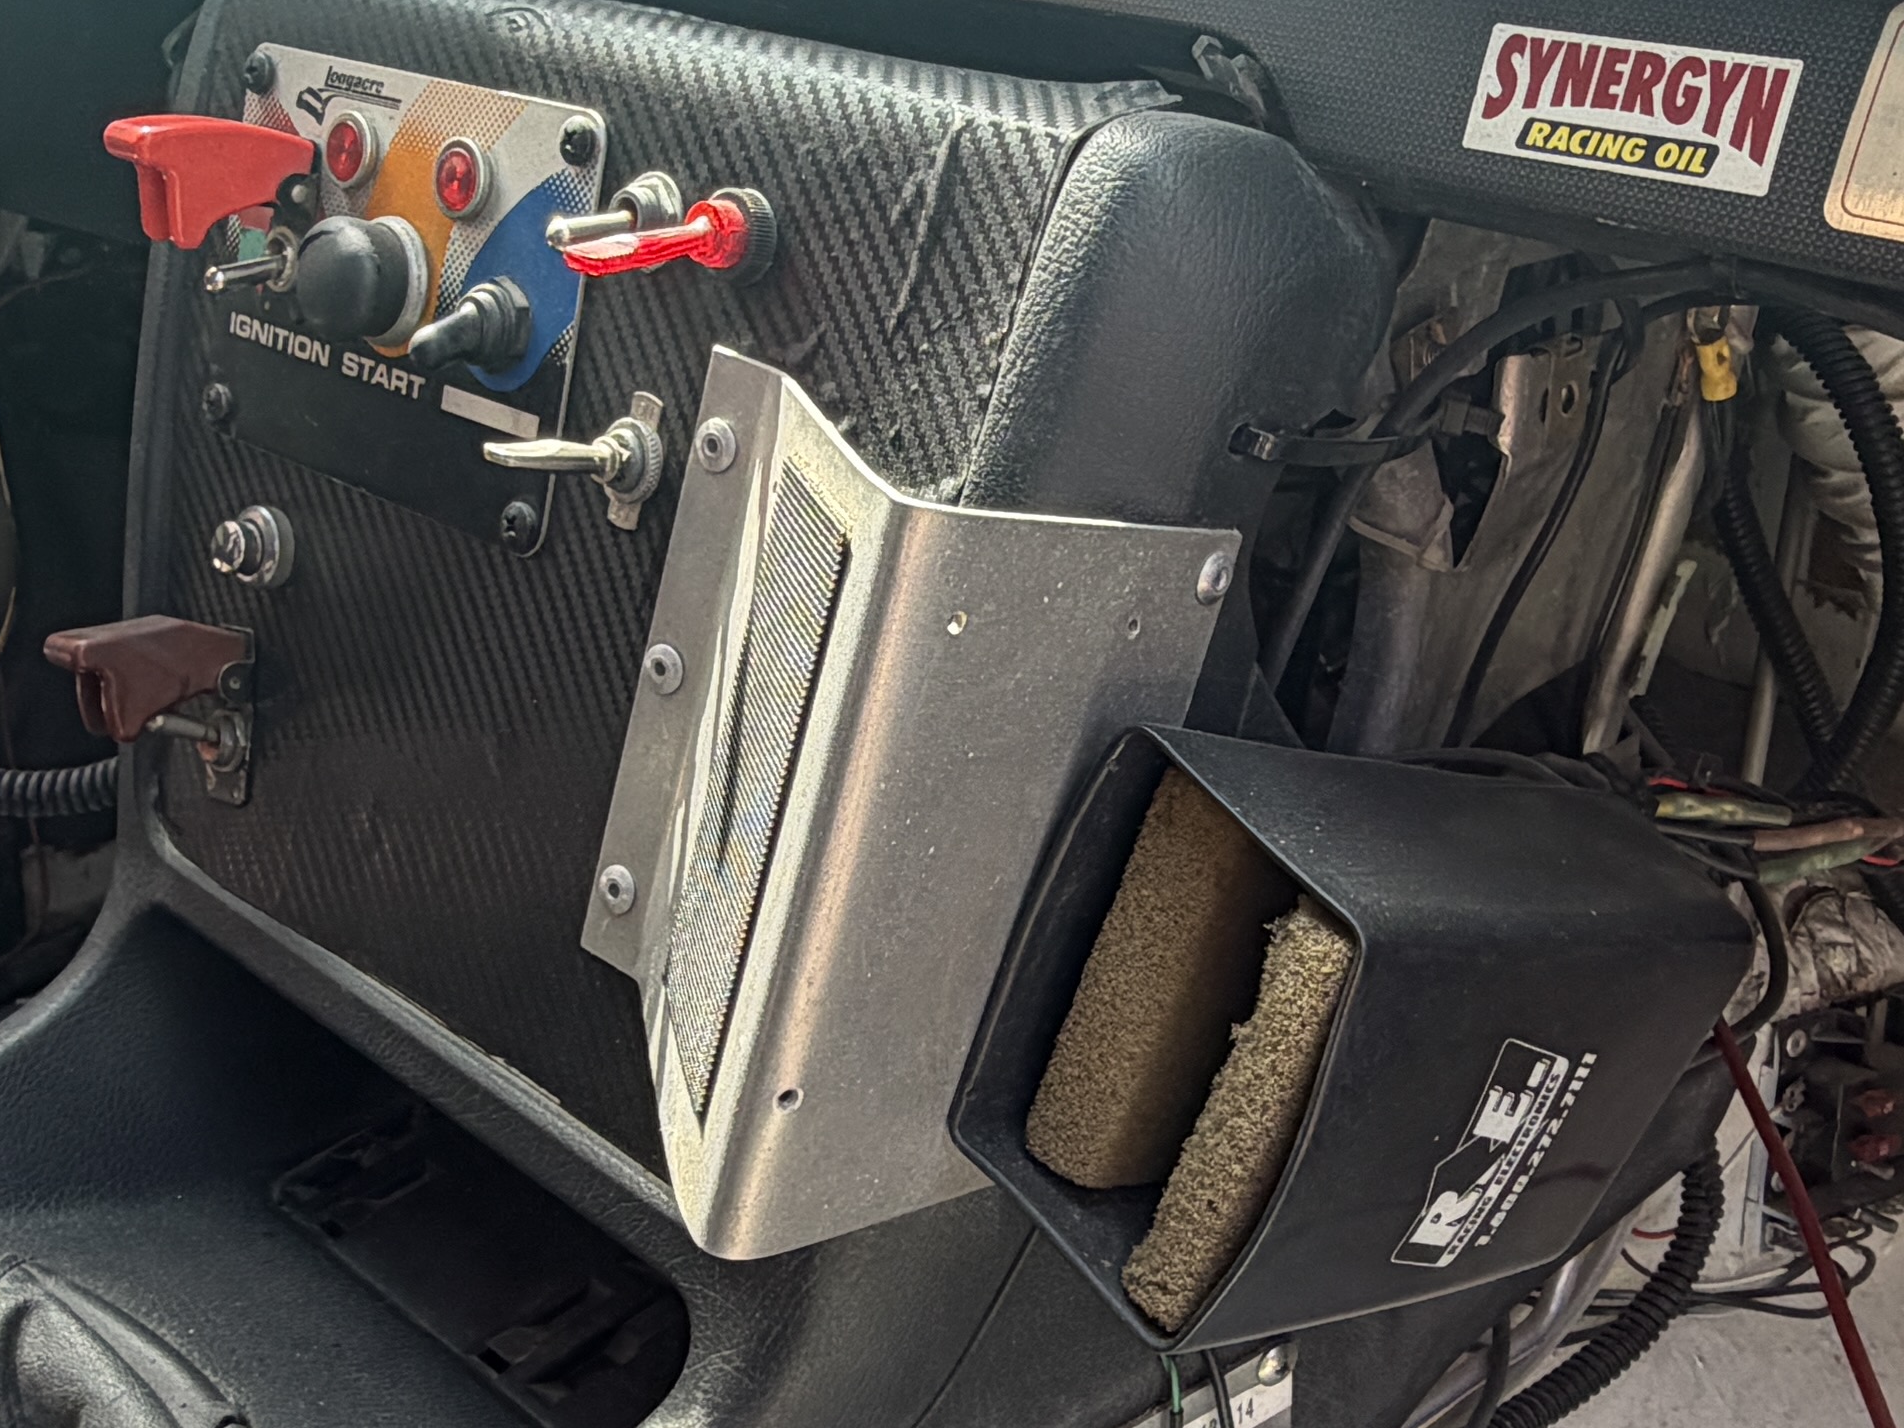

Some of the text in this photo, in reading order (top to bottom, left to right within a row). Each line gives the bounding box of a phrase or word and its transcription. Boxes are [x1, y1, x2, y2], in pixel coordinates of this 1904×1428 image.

[324, 65, 386, 96] Longacre
[1481, 33, 1791, 168] SYNERGYN
[1524, 121, 1709, 174] RACING OIL
[229, 311, 426, 400] IGNITION START
[1447, 1071, 1562, 1257] RACING ELECTRONICS
[1237, 1396, 1255, 1425] 14
